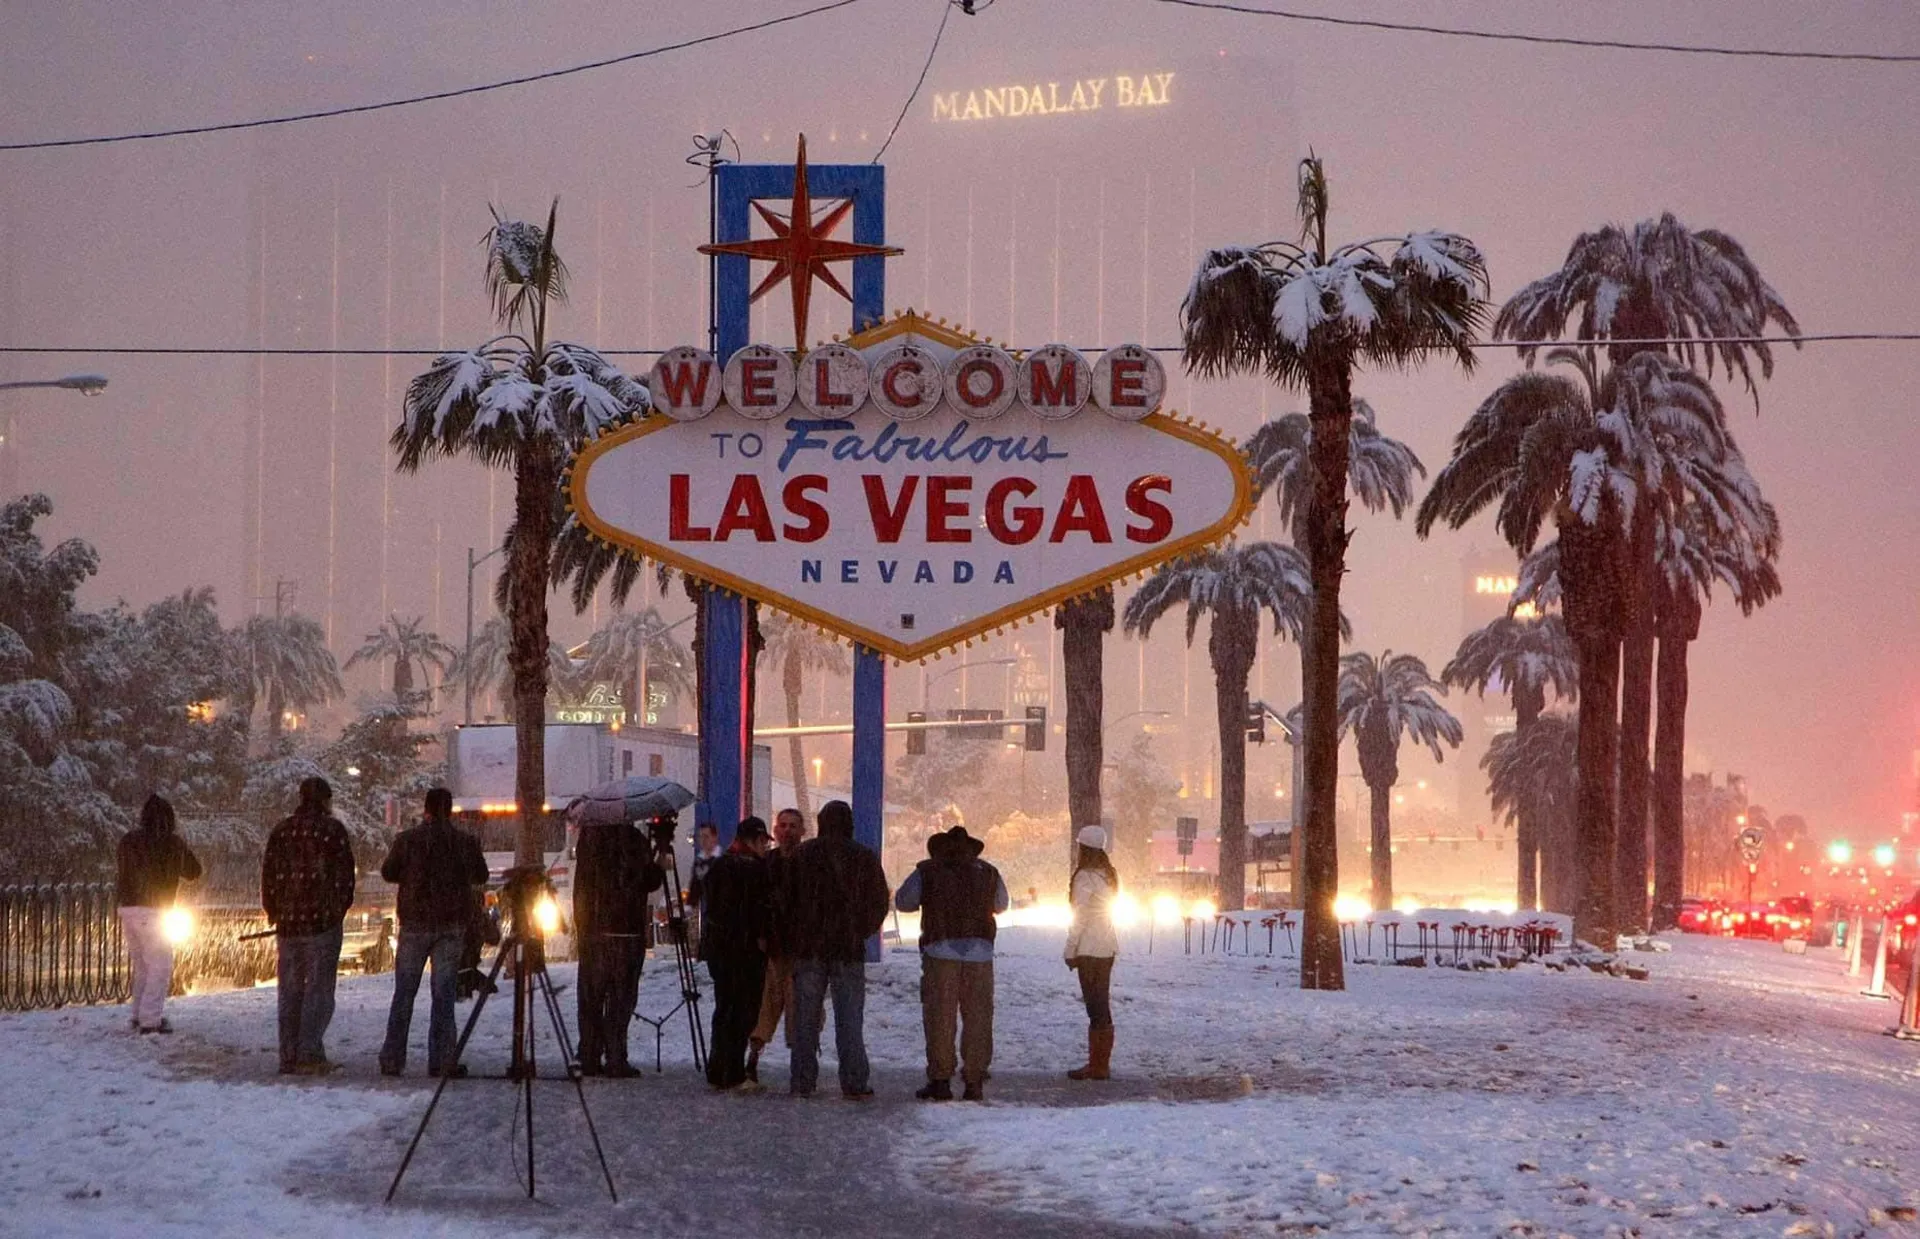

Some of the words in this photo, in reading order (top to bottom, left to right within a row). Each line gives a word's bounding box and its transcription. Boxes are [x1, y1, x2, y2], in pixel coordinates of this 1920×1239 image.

[931, 78, 1108, 123] MANDALAY
[1116, 72, 1175, 107] BAY
[656, 357, 1148, 408] WELCOME
[711, 432, 763, 458] TO
[777, 418, 1068, 473] Fabulous
[669, 474, 830, 543] LAS
[861, 474, 1173, 545] VEGAS
[801, 560, 1015, 584] NEVADA
